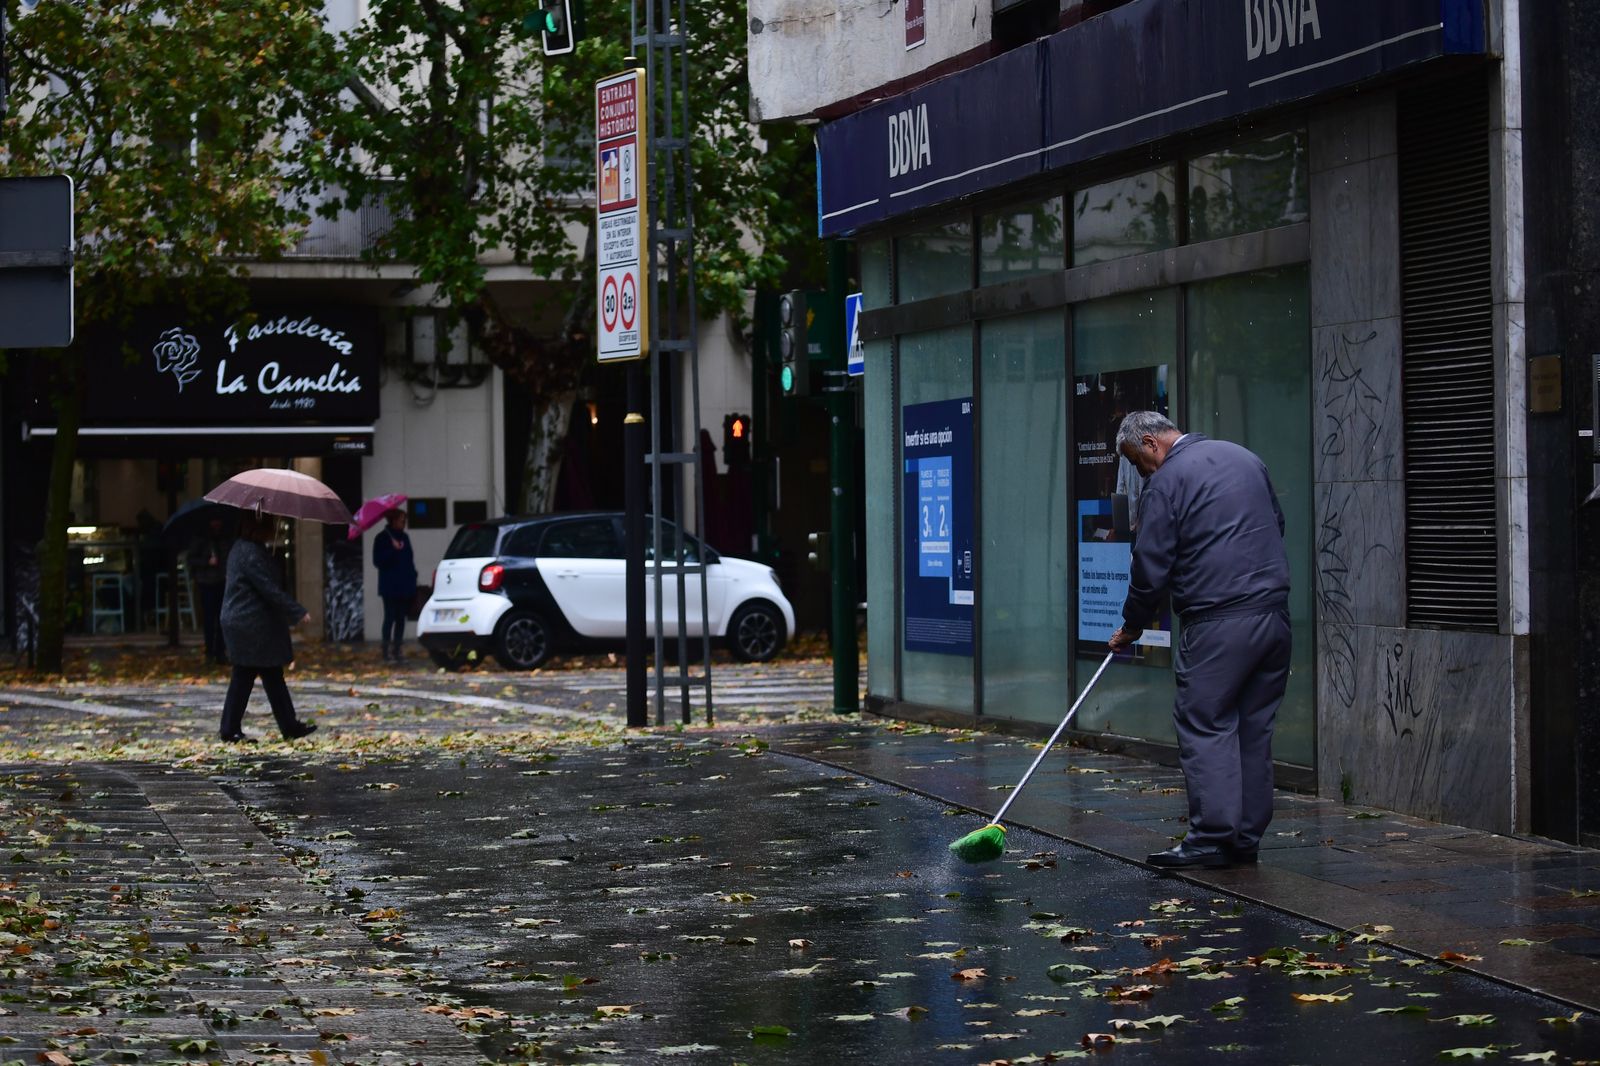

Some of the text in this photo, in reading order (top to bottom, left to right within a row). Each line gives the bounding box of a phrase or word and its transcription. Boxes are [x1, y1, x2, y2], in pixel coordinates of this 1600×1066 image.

[1245, 0, 1321, 61] BBVA
[602, 83, 632, 104] ENTRADA
[601, 99, 634, 120] CONJUNTO
[888, 103, 931, 178] BBVA
[606, 295, 616, 313] 30
[224, 315, 353, 355] Pastelería
[216, 359, 361, 394] La Camelia
[961, 402, 971, 415] BBVA
[905, 430, 919, 447] Invertir
[924, 433, 930, 445] es
[929, 432, 938, 445] una
[938, 426, 953, 448] opción
[1082, 569, 1091, 580] Todos
[1115, 573, 1129, 583] empresa
